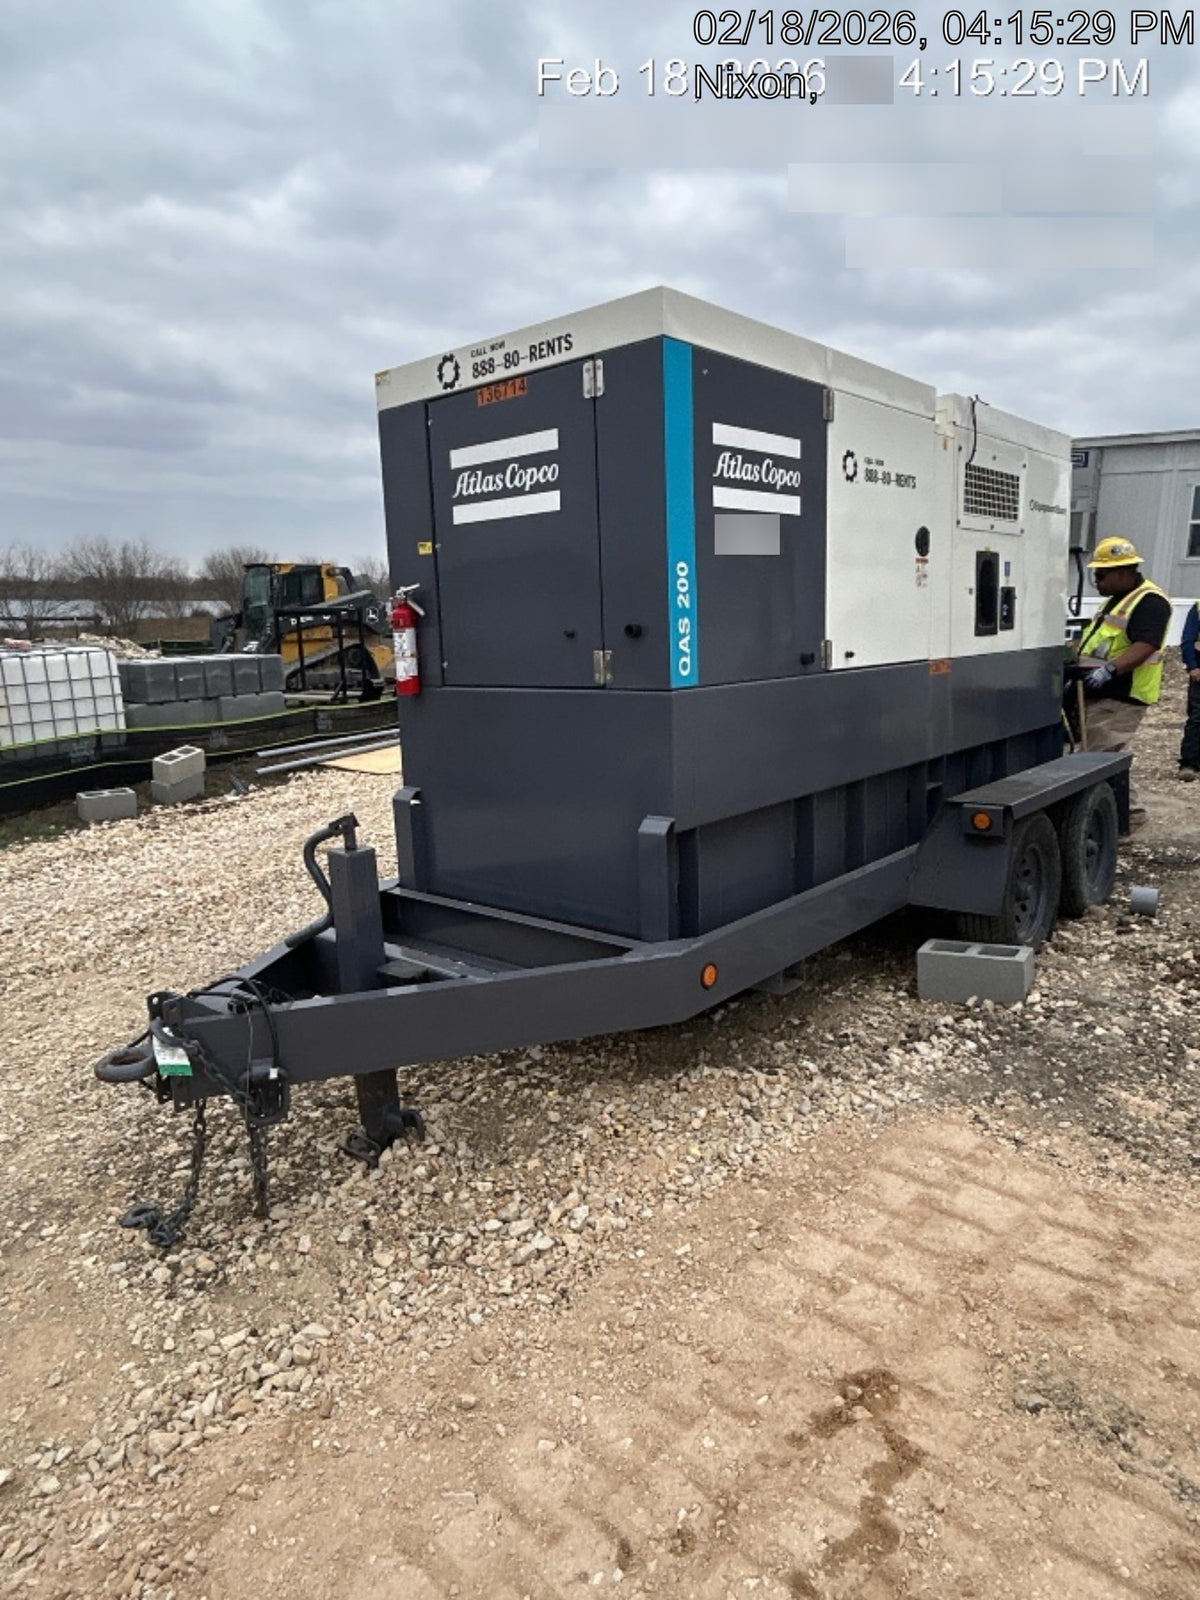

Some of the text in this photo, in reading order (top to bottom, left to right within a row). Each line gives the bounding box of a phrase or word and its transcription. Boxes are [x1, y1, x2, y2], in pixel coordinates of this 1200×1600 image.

[470, 347, 488, 358] CALL
[472, 333, 573, 379] 888-80-RENTS
[452, 463, 559, 498] Atlas Copco
[712, 452, 801, 490] Atlas Copco
[676, 561, 691, 677] QAS 200
